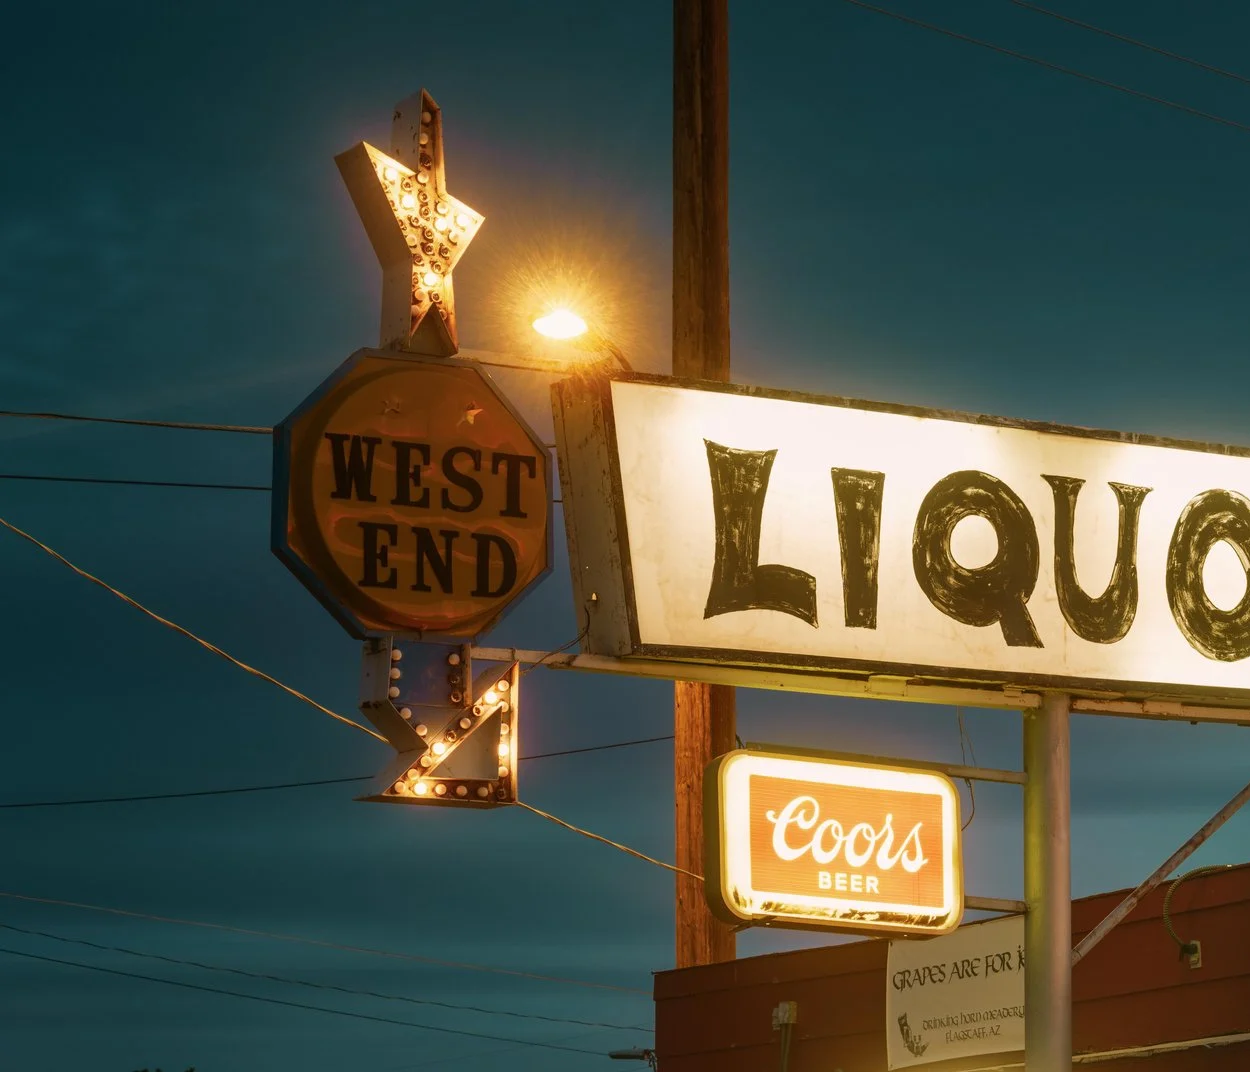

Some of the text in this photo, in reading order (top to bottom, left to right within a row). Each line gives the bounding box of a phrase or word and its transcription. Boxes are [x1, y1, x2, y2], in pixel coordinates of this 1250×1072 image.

[325, 432, 536, 518] WEST
[358, 521, 517, 598] END
[766, 796, 928, 873] Coors
[818, 871, 880, 894] BEER
[893, 963, 947, 992] GRAPES
[949, 958, 981, 984] ARE
[985, 951, 1013, 979] FOR
